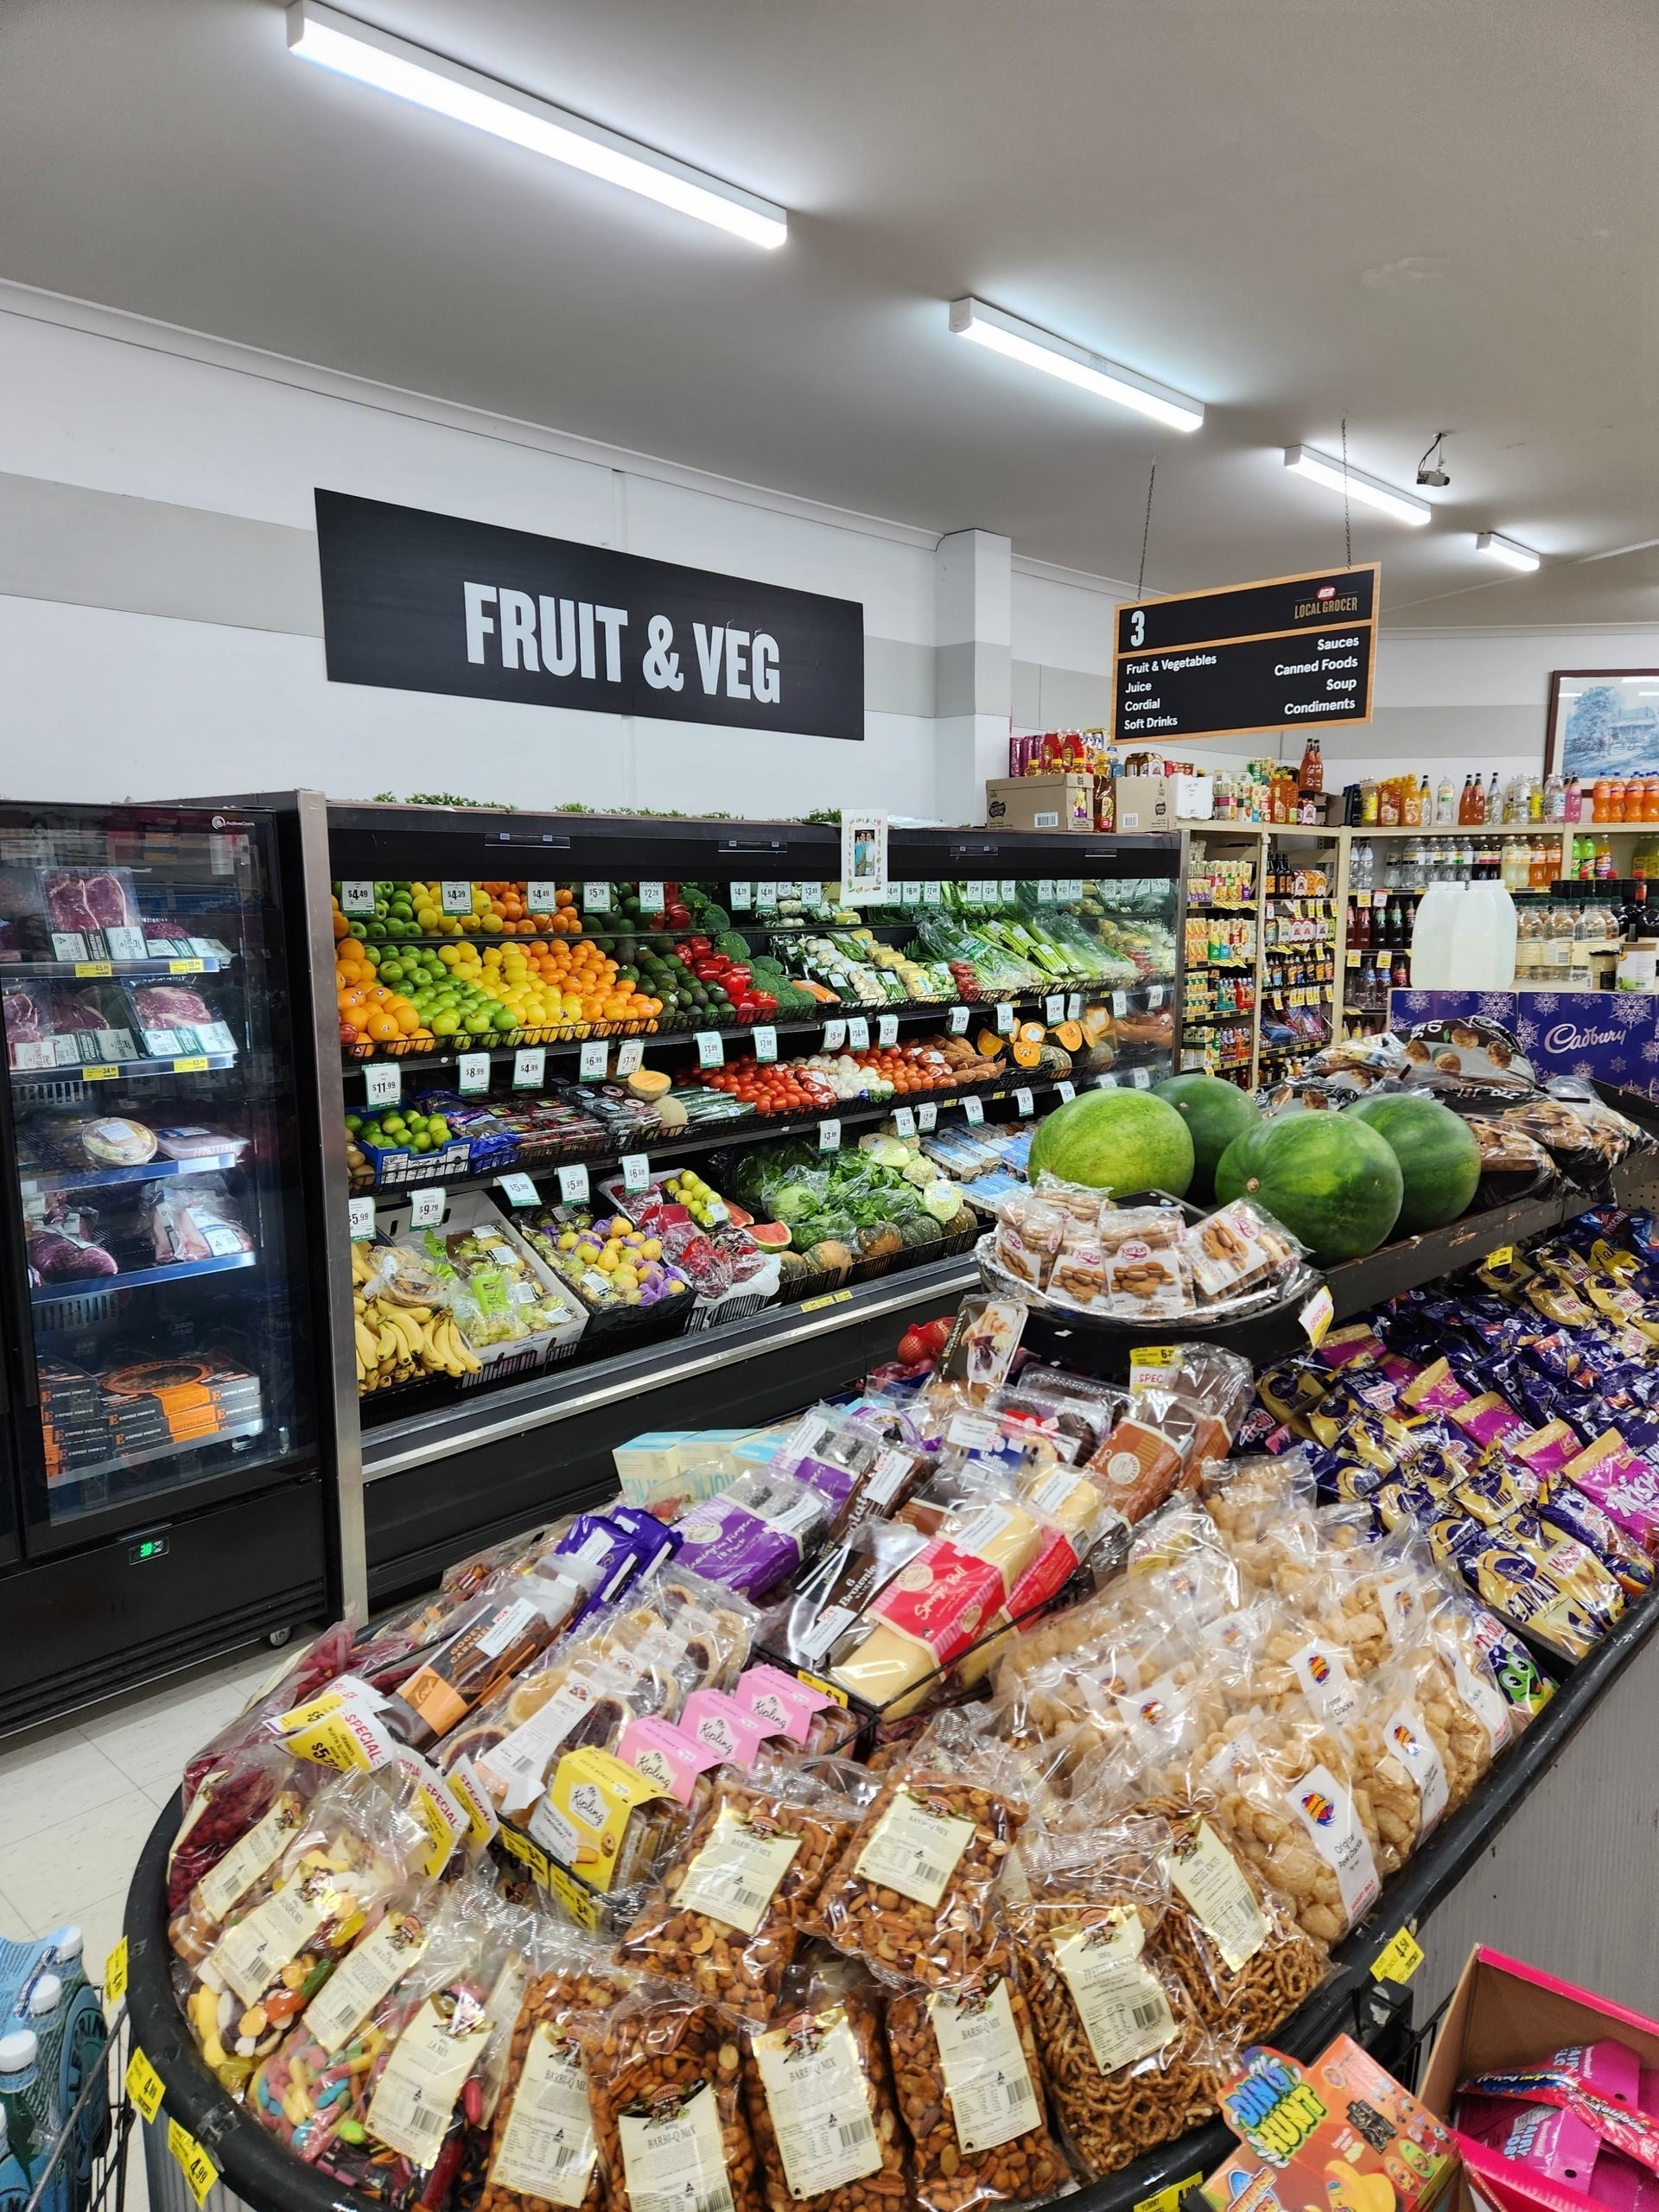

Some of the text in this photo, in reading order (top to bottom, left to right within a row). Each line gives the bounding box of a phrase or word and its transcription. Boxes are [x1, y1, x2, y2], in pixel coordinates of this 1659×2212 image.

[1294, 596, 1358, 620] LOCAL GROCER
[1130, 610, 1146, 647] 3
[463, 581, 780, 704] FRUIT & VEG
[1317, 635, 1360, 651] Sauces
[1126, 654, 1217, 675] Fruit & Vegetables
[1274, 656, 1358, 677] Canned Foods
[1125, 681, 1153, 694] Juice
[1325, 678, 1358, 692] Soup
[1125, 698, 1160, 712] Cordial
[1284, 697, 1357, 715] Condiments
[1123, 715, 1179, 731] Soft Drinks
[1544, 1023, 1627, 1054] Cadbury
[467, 1068, 485, 1078] $8.99
[520, 1065, 538, 1073] $4.99
[586, 1056, 602, 1066] $6.99
[372, 1082, 396, 1093] $11.99
[419, 1205, 439, 1215] $9.79
[1602, 1210, 1628, 1236] Pascall
[685, 1517, 757, 1570] Lamington Fingers
[728, 1538, 746, 1553] Pack
[839, 1564, 877, 1607] Brownie
[846, 1578, 855, 1587] 6
[914, 1565, 969, 1621] Sponge Roll
[450, 1624, 482, 1656] GOOEY
[752, 1700, 786, 1729] Kipling
[346, 1713, 381, 1761] SPECIAL
[700, 1722, 734, 1756] Kipling
[637, 1755, 671, 1789] Kipling
[425, 1783, 459, 1828] SPECIAL
[572, 1789, 605, 1827] Kipling
[1334, 1831, 1355, 1854] Original
[544, 2070, 588, 2092] BARBI-Q MI
[1225, 2066, 1296, 2127] DINO
[1255, 2084, 1327, 2157] HUNT
[648, 2124, 696, 2150] BARBI-Q MIX
[1516, 2124, 1538, 2157] AIRY
[190, 2158, 207, 2184] 4.99
[1141, 2198, 1160, 2211] YUMMY
